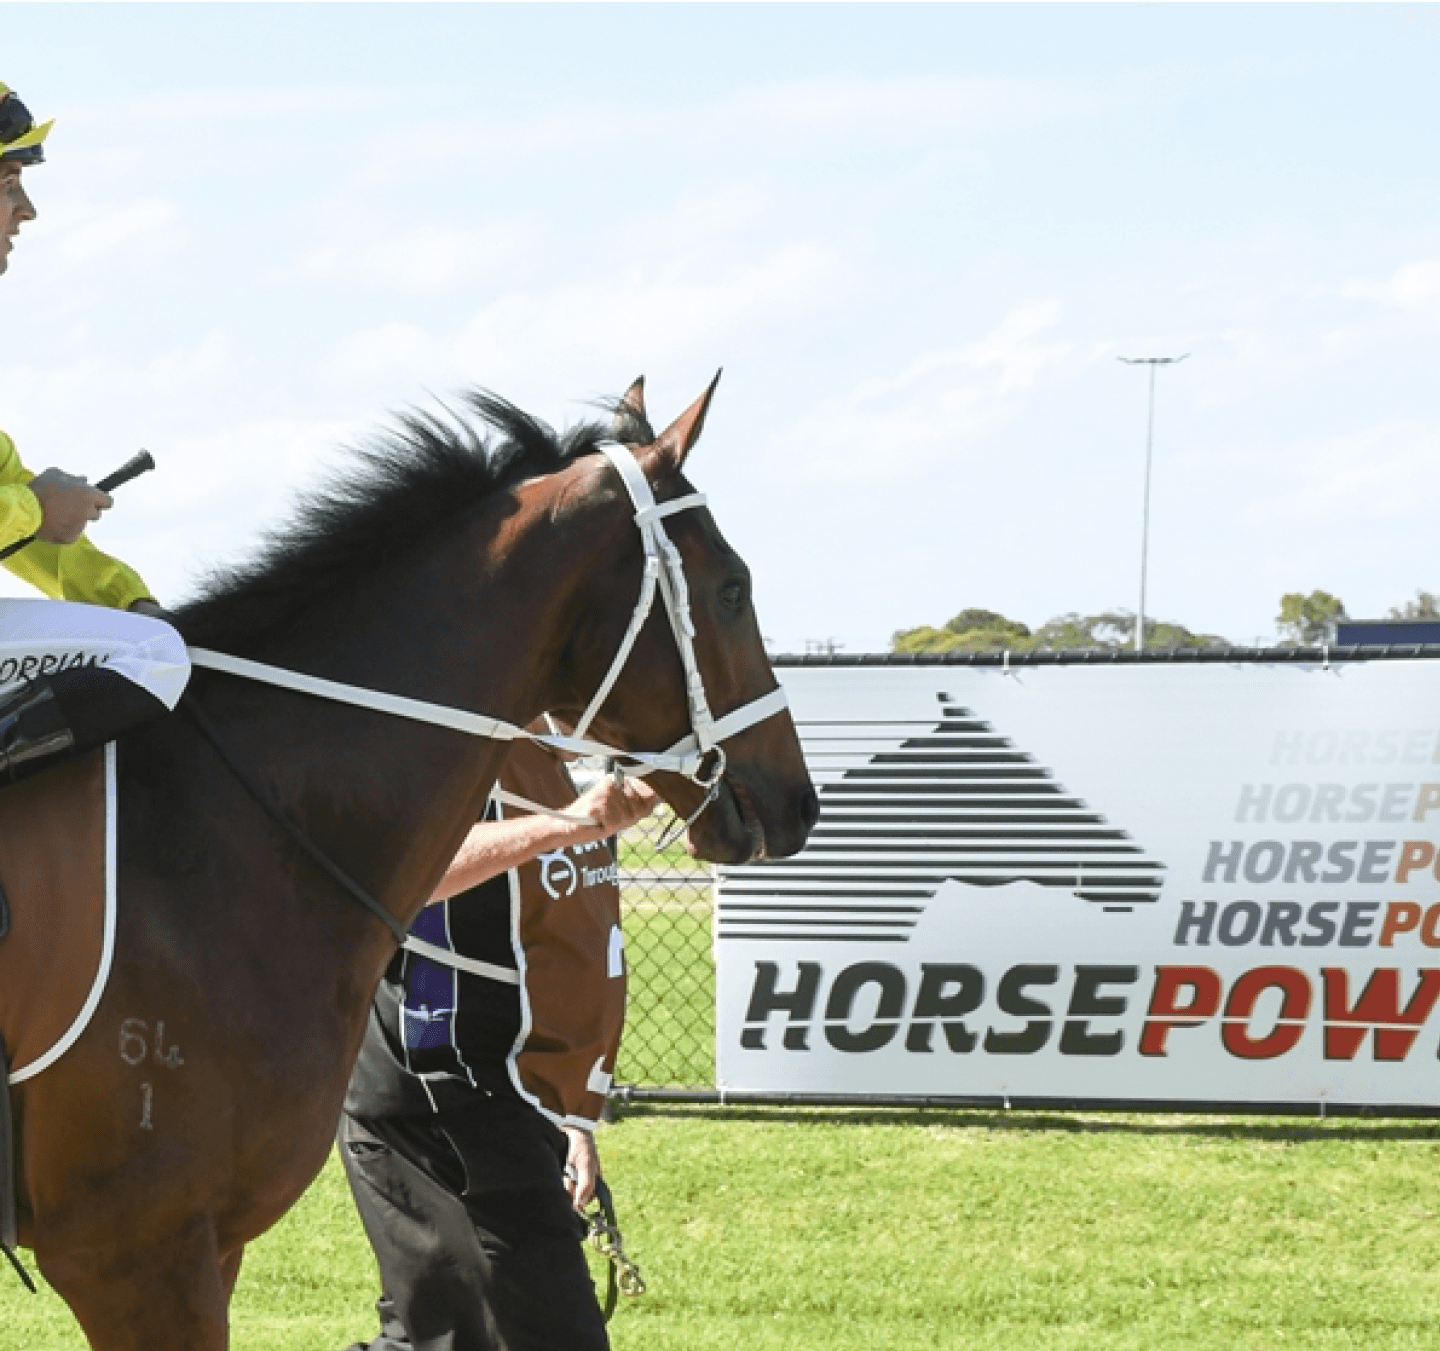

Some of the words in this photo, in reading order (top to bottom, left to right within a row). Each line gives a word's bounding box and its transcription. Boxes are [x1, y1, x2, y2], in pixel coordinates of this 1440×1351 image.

[1269, 728, 1440, 765] HORSE
[1201, 839, 1440, 884] HORSEP
[739, 960, 1440, 1063] HORSEPOW
[120, 1018, 185, 1068] 64
[140, 1083, 153, 1130] 1
